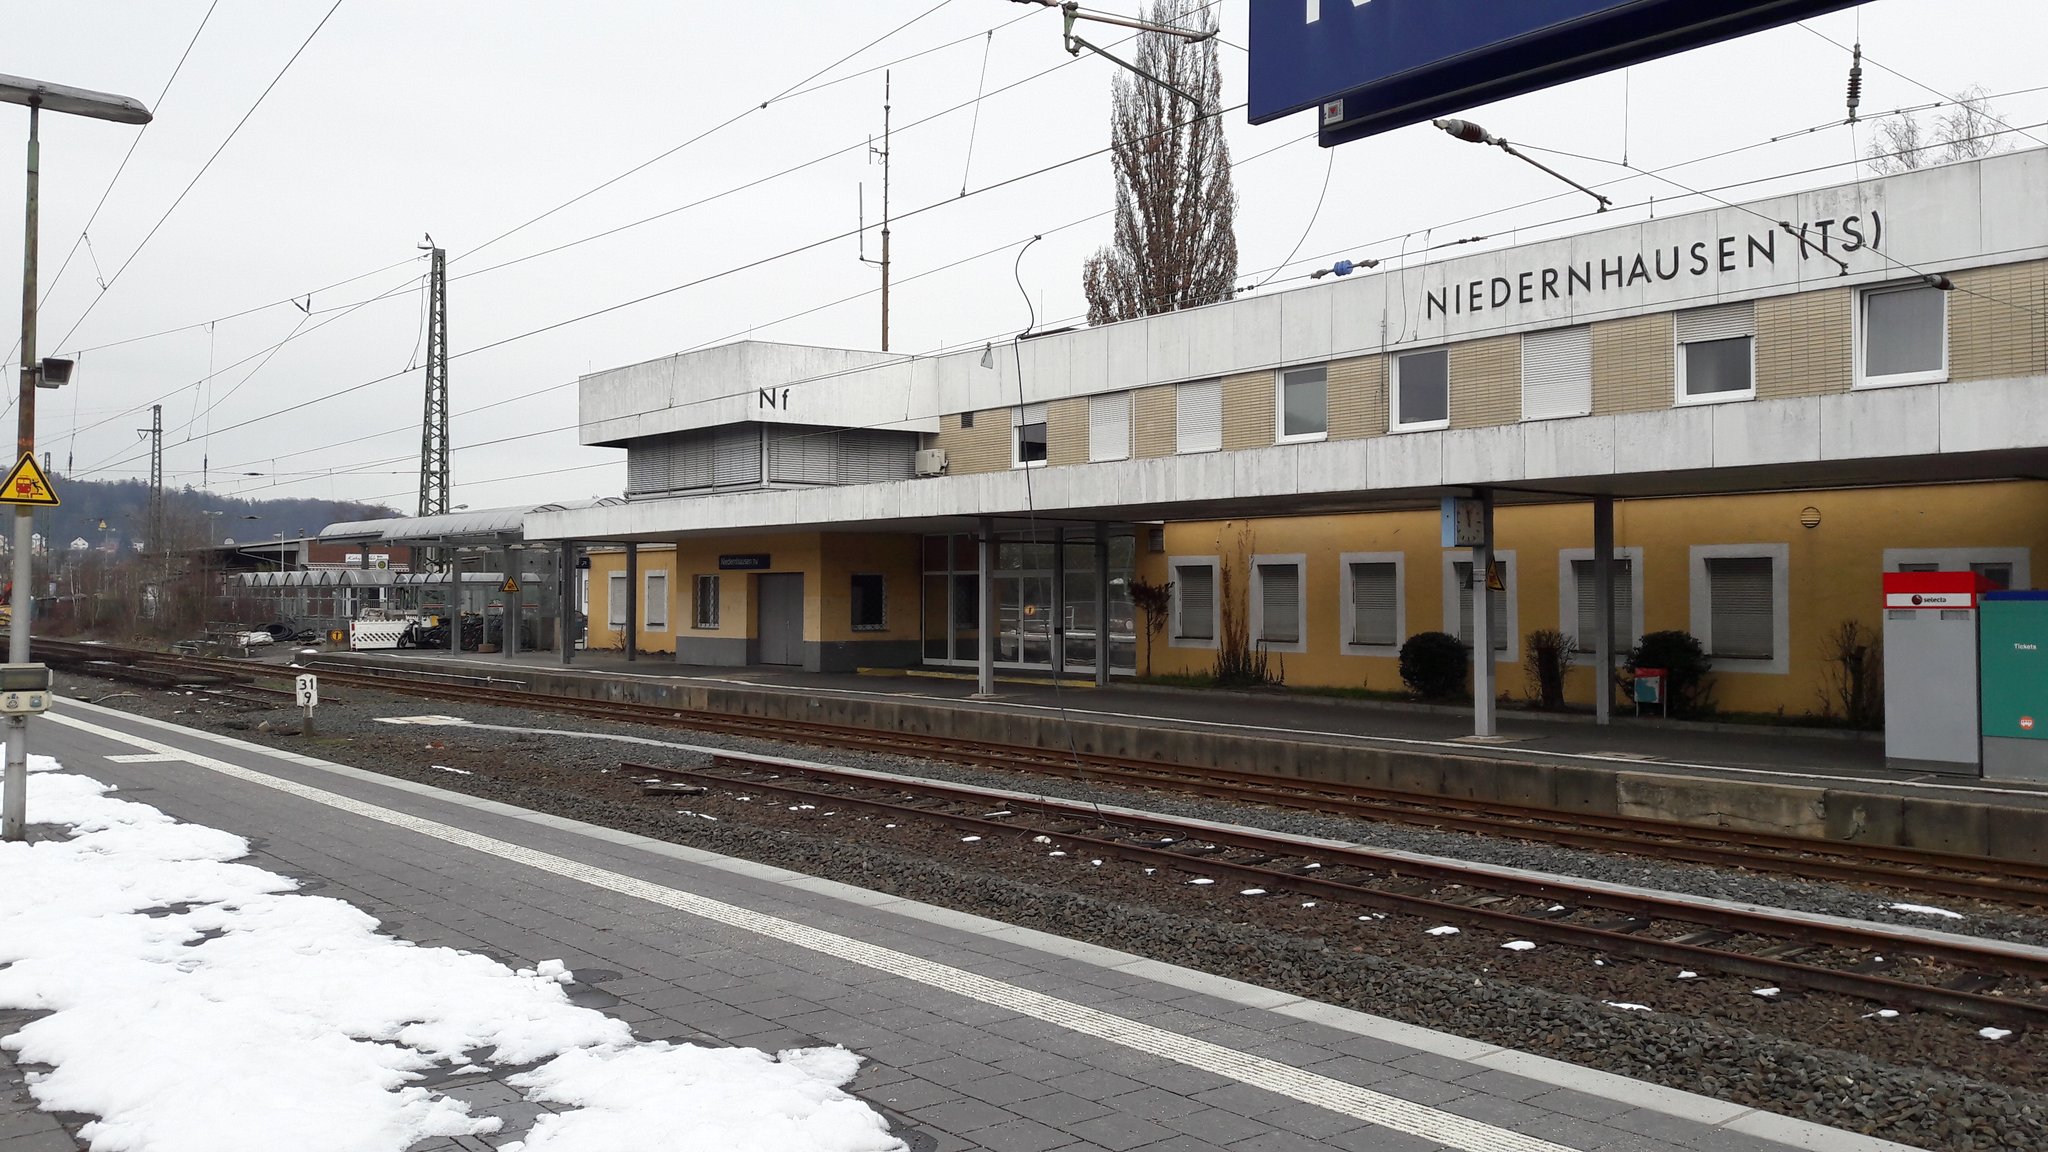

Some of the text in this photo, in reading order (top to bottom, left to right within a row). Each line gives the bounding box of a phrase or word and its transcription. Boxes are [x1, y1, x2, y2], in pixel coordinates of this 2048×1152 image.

[1427, 210, 1881, 319] NIEDERNHAUSEN (TS)
[759, 386, 790, 410] Nf
[299, 678, 313, 690] 31
[304, 691, 312, 704] 9
